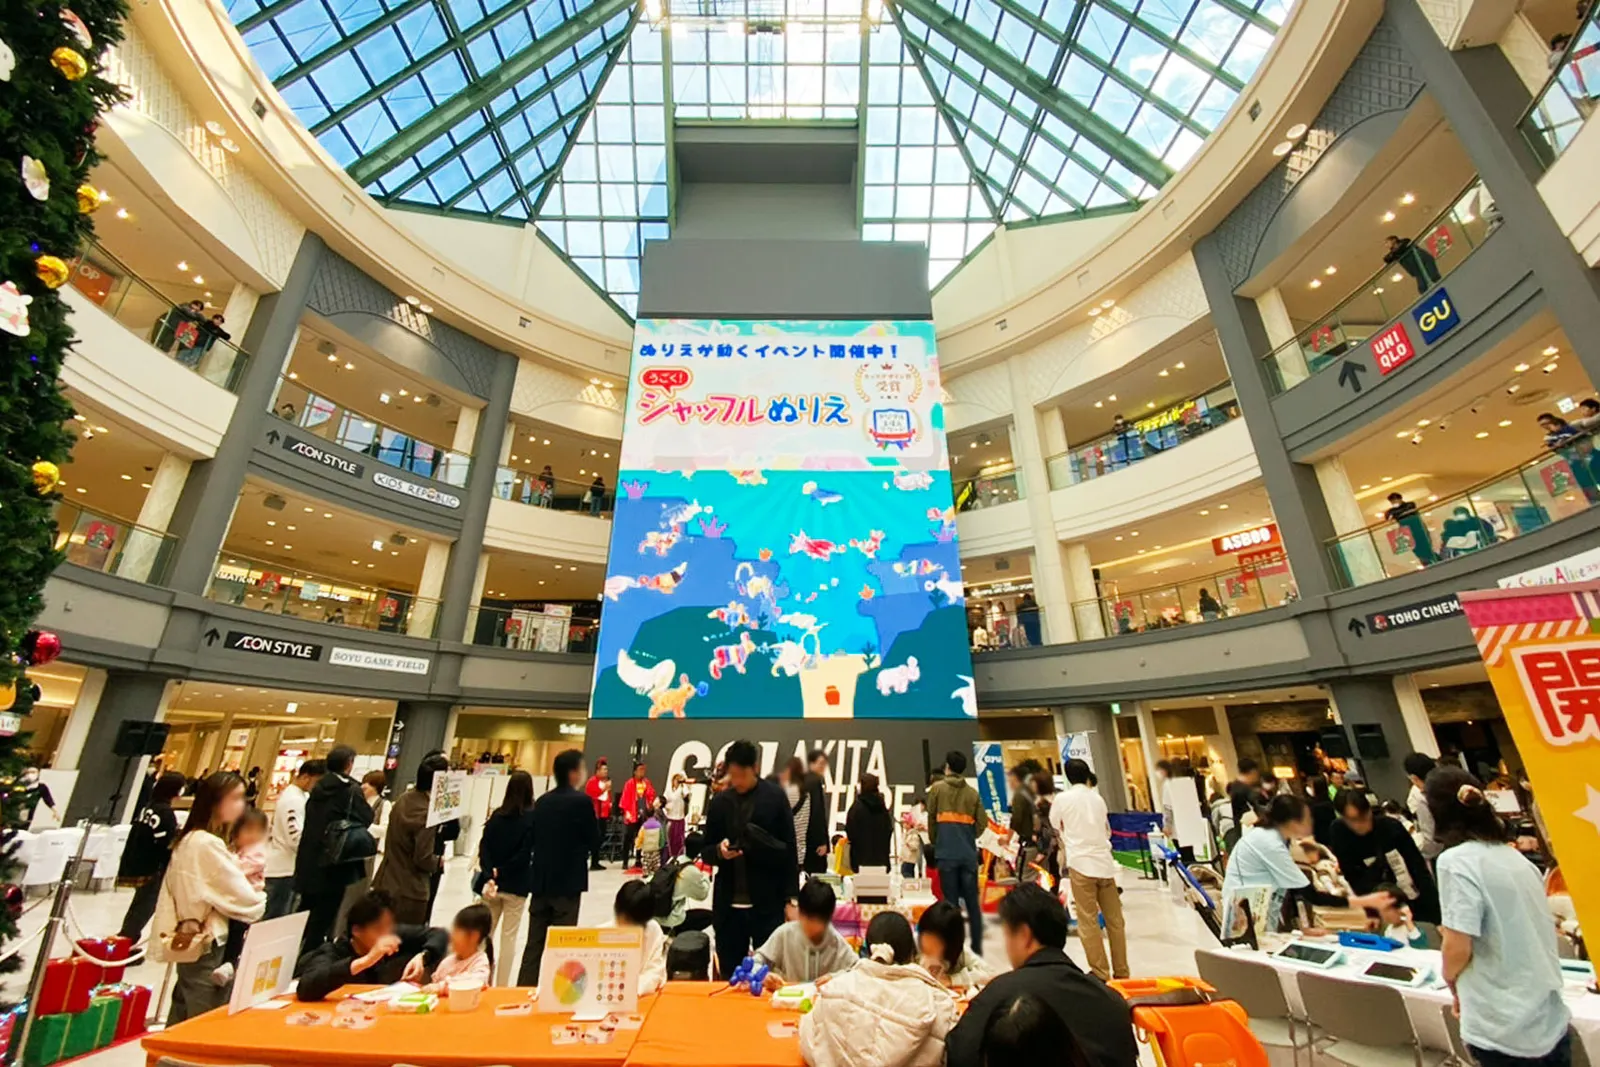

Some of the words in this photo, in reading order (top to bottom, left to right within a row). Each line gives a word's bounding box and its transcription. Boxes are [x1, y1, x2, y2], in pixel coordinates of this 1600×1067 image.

[1419, 299, 1451, 332] GU
[1374, 330, 1400, 354] UNI
[1380, 343, 1407, 367] QLO
[323, 453, 357, 475] STYLE
[376, 473, 403, 490] KIDS
[1387, 608, 1421, 626] TOHO
[1421, 600, 1464, 619] CINEM
[274, 641, 314, 659] STYLE
[334, 651, 361, 664] SOYU
[364, 656, 394, 668] GAME
[395, 660, 425, 671] FIELD
[791, 739, 891, 795] AKITA
